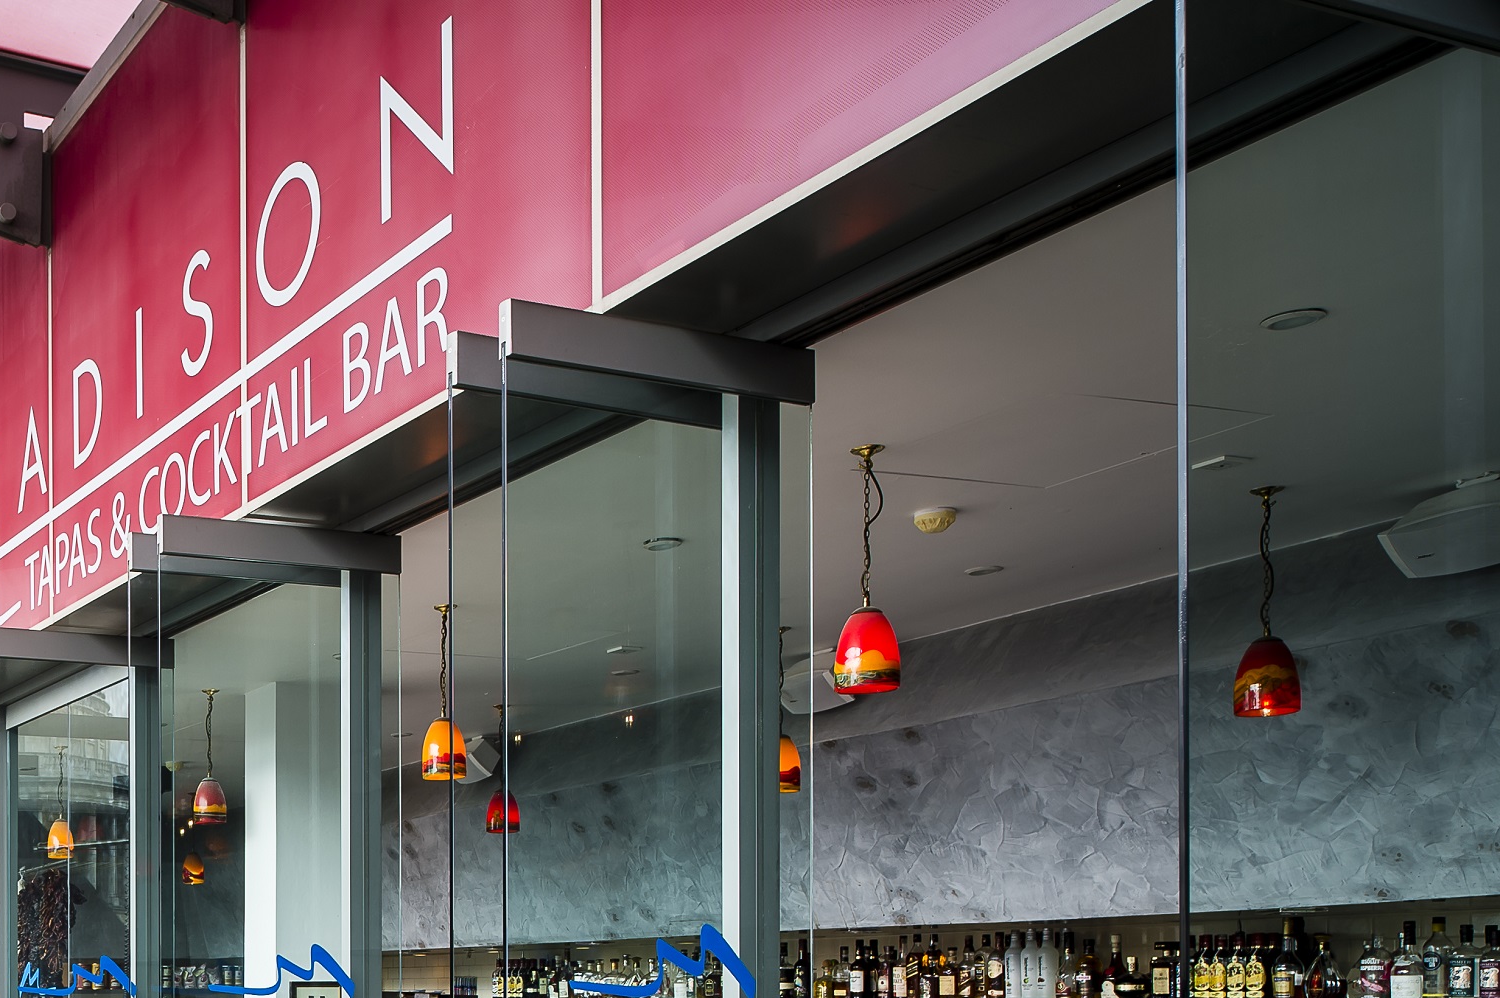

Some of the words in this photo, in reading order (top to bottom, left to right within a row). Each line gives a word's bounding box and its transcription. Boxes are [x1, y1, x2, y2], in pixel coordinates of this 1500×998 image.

[25, 509, 102, 611] TAPAS
[110, 491, 132, 553] &
[137, 357, 329, 535] COCKTAIL
[342, 267, 451, 414] BAR
